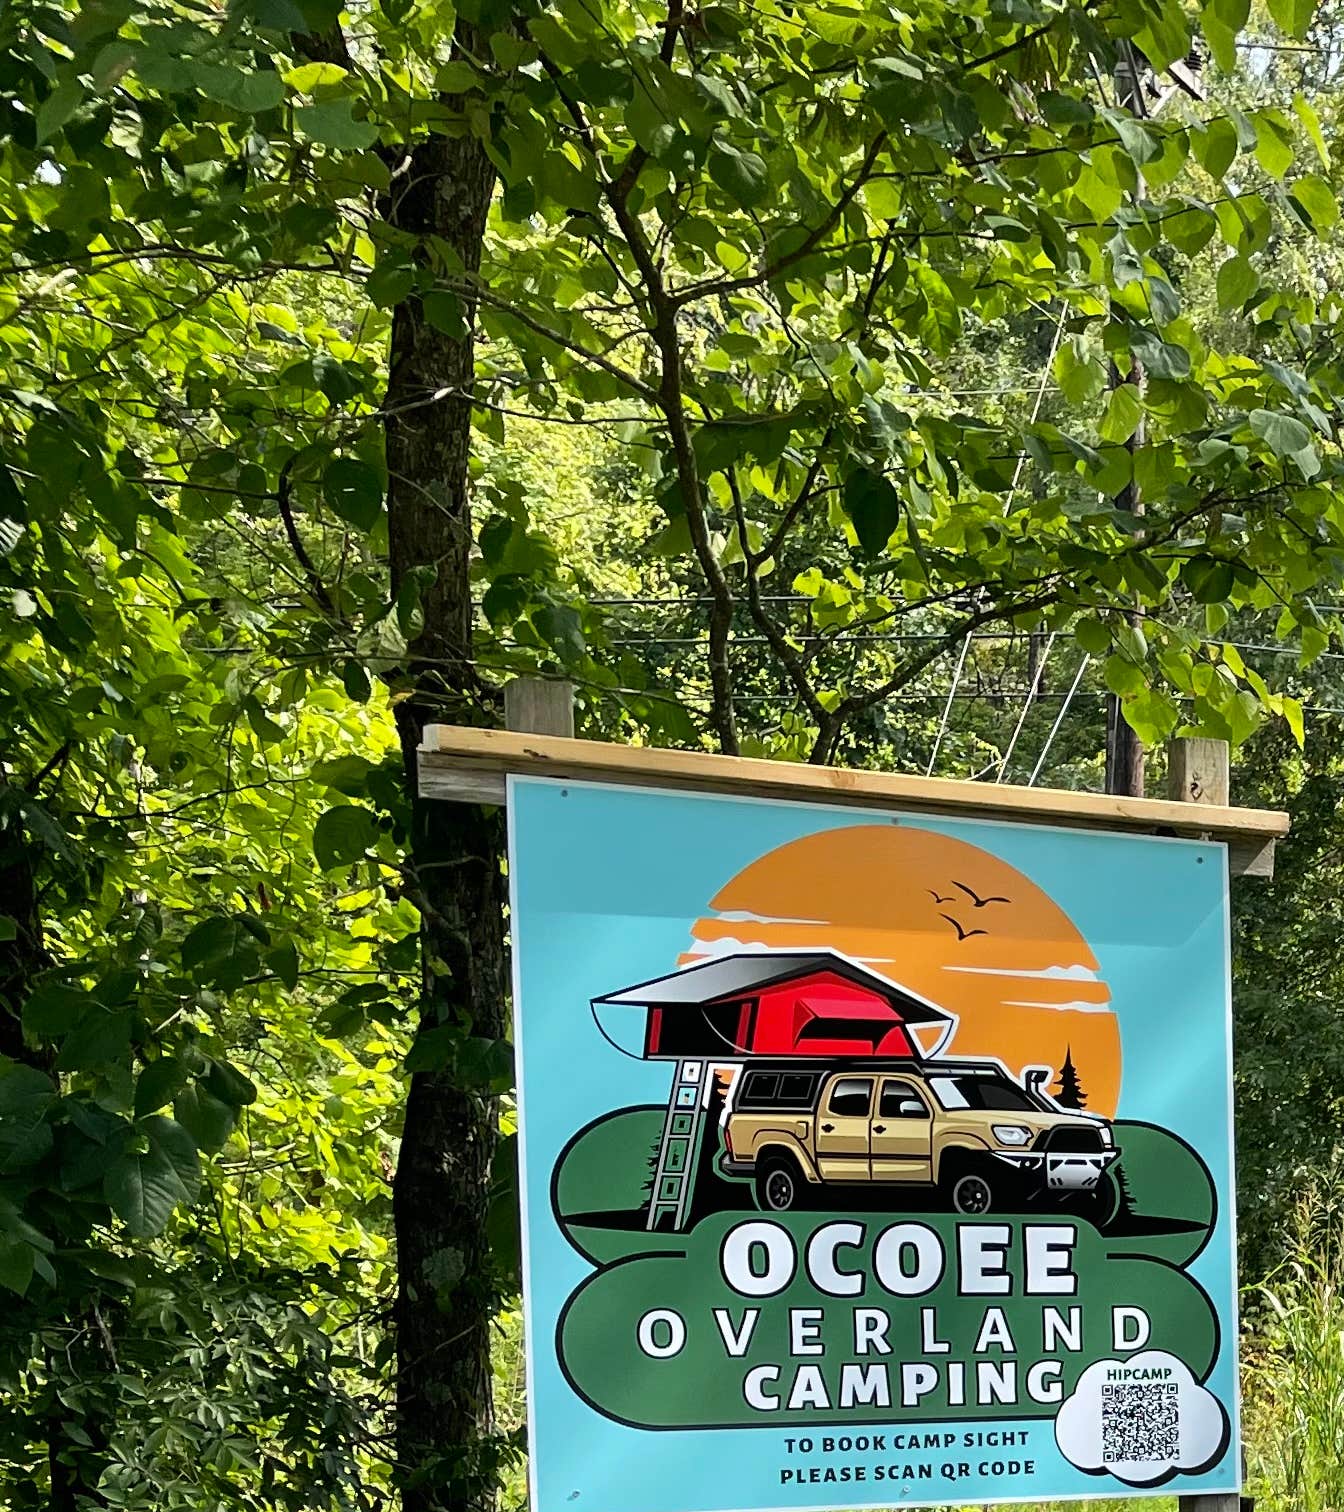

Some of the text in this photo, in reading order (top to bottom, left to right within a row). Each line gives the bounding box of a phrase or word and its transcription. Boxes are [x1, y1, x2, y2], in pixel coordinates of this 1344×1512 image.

[720, 1219, 1079, 1298] OCOEE
[637, 1304, 1152, 1359] OVERLAND
[742, 1359, 1065, 1411] CAMPING
[1106, 1368, 1173, 1381] HIPCAMP
[784, 1431, 1030, 1454] TO BOOK CAMP SIGHT
[780, 1460, 1036, 1484] PLEASE SCAN QR CODE
